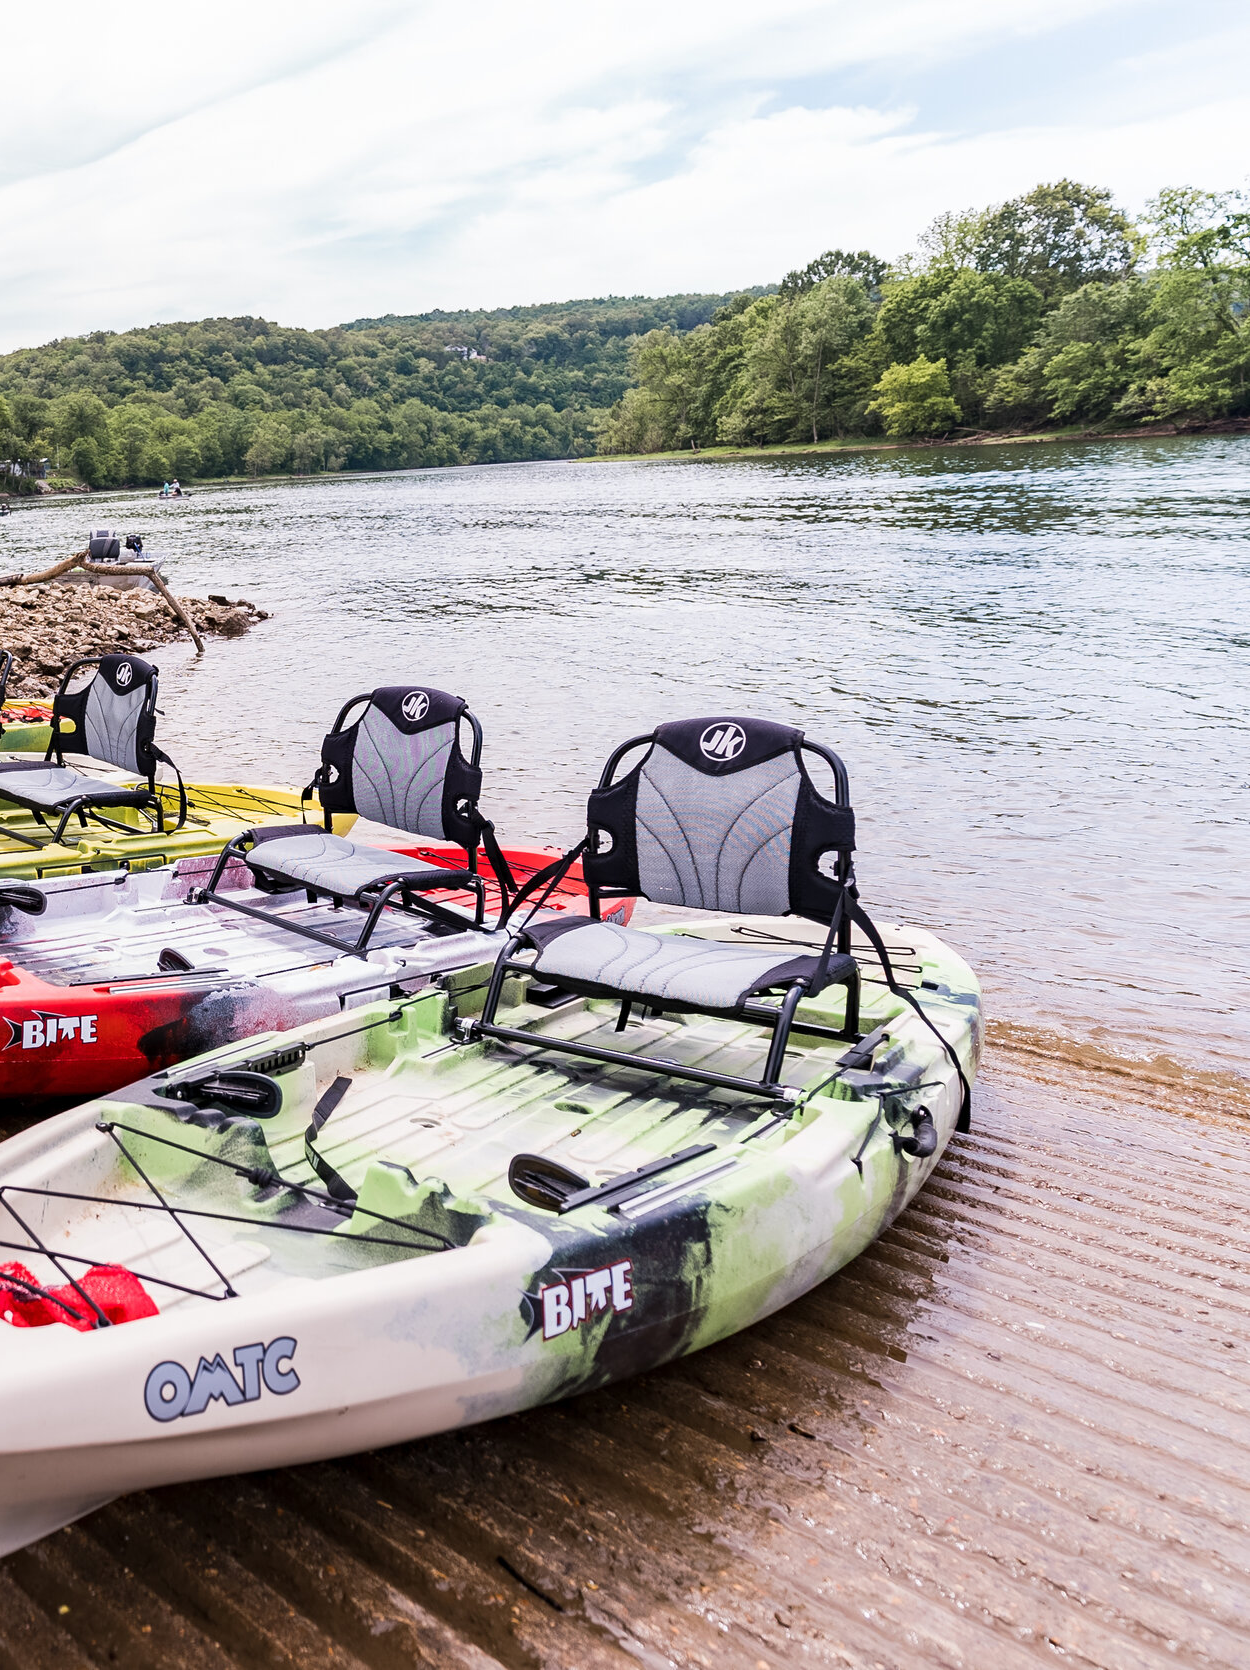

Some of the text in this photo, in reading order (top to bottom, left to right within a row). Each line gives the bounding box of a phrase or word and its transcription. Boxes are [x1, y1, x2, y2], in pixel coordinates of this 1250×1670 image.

[21, 1014, 99, 1050] BITE
[541, 1259, 634, 1341] BITE
[144, 1336, 300, 1422] OMTC
